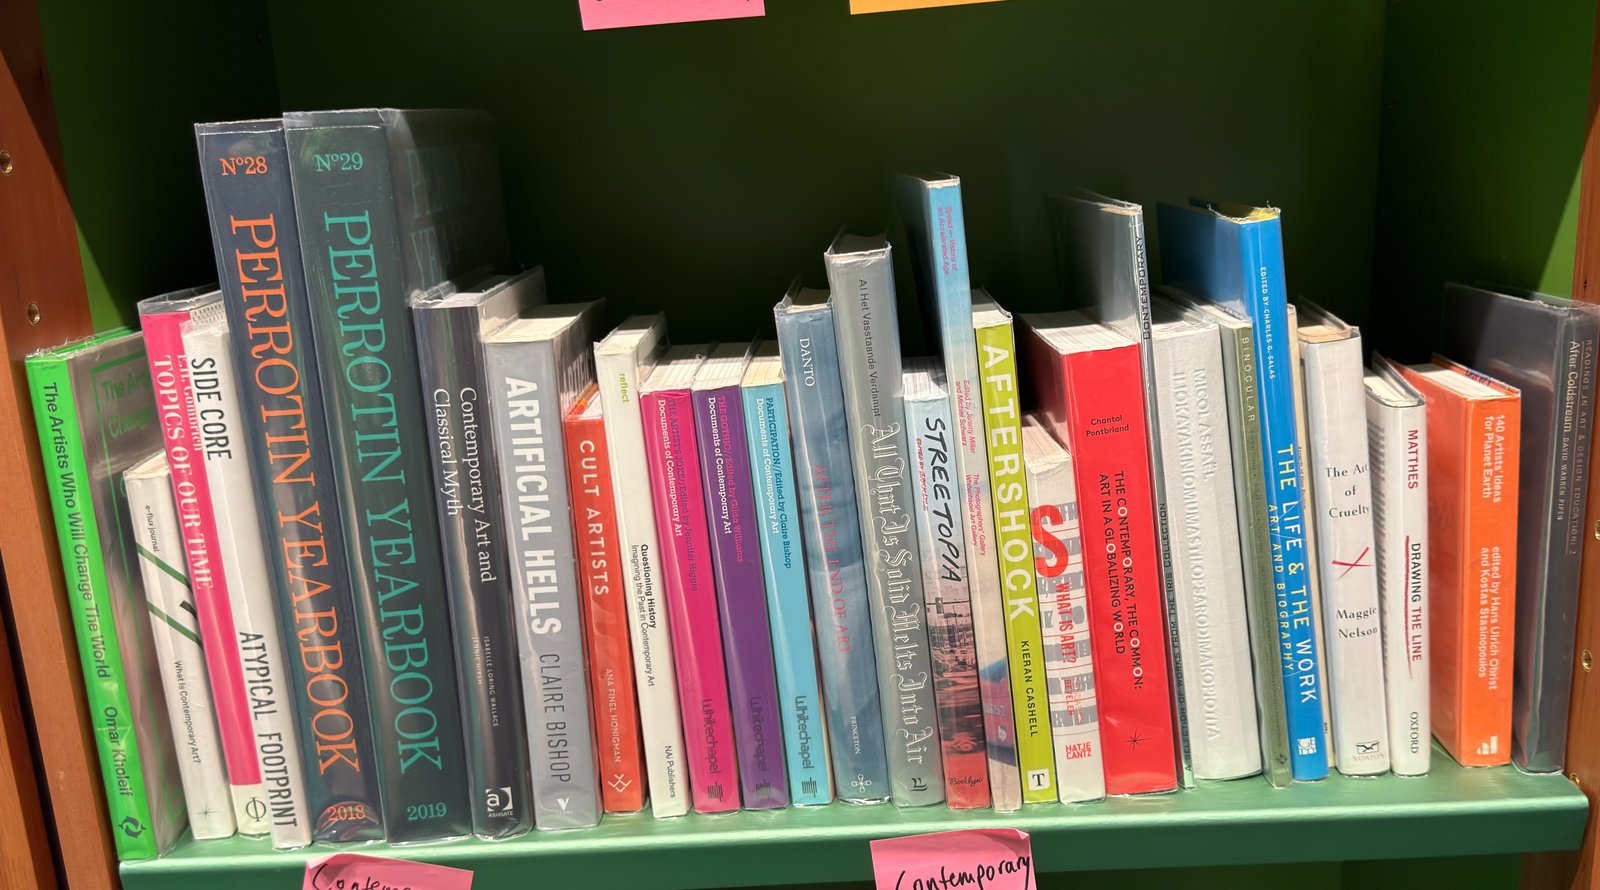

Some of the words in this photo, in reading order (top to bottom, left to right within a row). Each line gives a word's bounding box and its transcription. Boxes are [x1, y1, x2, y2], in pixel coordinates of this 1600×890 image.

[861, 293, 869, 310] Het
[1136, 236, 1150, 339] CONTEMPORARY
[863, 312, 876, 370] Vasstaande
[1569, 340, 1580, 368] After
[191, 357, 222, 402] SIDE
[800, 337, 816, 386] DANTO
[1242, 338, 1255, 422] BINOCULAR
[44, 382, 58, 412] The
[154, 355, 184, 440] TOPICS
[619, 373, 629, 403] reflect
[868, 371, 881, 417] Verdampt
[1564, 371, 1578, 433] Coldstream
[201, 409, 232, 460] CORE
[434, 388, 457, 467] Classical
[659, 399, 671, 449] Documents
[709, 397, 720, 447] Documents
[757, 398, 768, 447] Documents
[1086, 425, 1129, 437] Pontbriand
[1091, 415, 1122, 426] Chantal
[1485, 416, 1494, 430] for
[1496, 415, 1505, 432] 140
[50, 414, 68, 469] Artists
[460, 387, 485, 514] Contemporary
[505, 376, 553, 541] ARTIFICIAL
[665, 450, 672, 459] of
[715, 447, 722, 456] of
[763, 448, 769, 457] of
[861, 422, 901, 459] All
[1483, 433, 1493, 466] Planet
[172, 447, 192, 476] OF
[579, 440, 599, 496] CULT
[1277, 444, 1296, 490] THE
[1325, 467, 1348, 478] The
[1408, 430, 1418, 489] MATTHES
[60, 472, 76, 508] Who
[230, 213, 316, 486] PERROTIN
[278, 501, 360, 775] YEARBOOK
[323, 210, 405, 485] PERROTIN
[366, 498, 442, 774] YEARBOOK
[441, 470, 464, 516] Myth
[665, 460, 680, 522] Contemporary
[715, 458, 729, 520] Contemporary
[763, 458, 777, 520] Contemporary
[814, 463, 833, 514] AFTER
[868, 457, 906, 515] That
[925, 418, 962, 582] STREETOPIA
[983, 344, 1034, 621] AFTERSHOCK
[1099, 473, 1110, 497] ART
[1115, 471, 1125, 494] THE
[1345, 485, 1358, 497] of
[1483, 468, 1492, 498] Earth
[1493, 475, 1503, 503] Ideas
[178, 482, 201, 528] OUR
[1102, 500, 1111, 513] IN
[1103, 516, 1113, 525] A
[1269, 504, 1280, 533] ART
[1329, 505, 1370, 518] Cruelty
[67, 512, 85, 540] Will
[475, 519, 491, 547] Art
[724, 520, 732, 534] Art
[821, 522, 838, 550] THE
[872, 514, 910, 547] Is
[1159, 503, 1171, 567] COLLECTION
[1282, 501, 1302, 551] LIFE
[188, 533, 214, 590] TIME
[478, 550, 497, 583] and
[586, 508, 609, 595] ARTISTS
[630, 545, 642, 581] Imagining
[1104, 527, 1122, 608] GLOBALIZING
[1117, 497, 1135, 601] CONTEMPORARY,
[1273, 543, 1284, 572] AND
[1481, 547, 1489, 566] and
[1492, 546, 1500, 578] edited
[74, 544, 92, 602] Change
[641, 544, 653, 596] Questioning
[647, 598, 656, 628] History
[828, 559, 843, 594] END
[878, 549, 913, 604] Solid
[1288, 562, 1304, 575] &
[1411, 543, 1421, 602] DRAWING
[1480, 569, 1489, 605] Kostas
[1490, 581, 1500, 593] by
[524, 550, 562, 634] HELLS
[636, 582, 644, 594] the
[638, 596, 646, 612] Past
[1055, 582, 1071, 615] WHAT
[86, 604, 99, 632] The
[833, 597, 846, 619] OF
[1127, 603, 1137, 626] THE
[1290, 585, 1309, 629] THE
[1336, 607, 1377, 622] Maggie
[1412, 608, 1422, 630] THE
[1491, 597, 1499, 623] Hans
[836, 624, 852, 656] ART
[882, 602, 921, 671] Melts
[1059, 620, 1073, 632] IS
[1112, 612, 1126, 655] WORLD
[1277, 583, 1293, 671] BIOGRAPHY
[1338, 626, 1378, 639] Nelson
[1477, 607, 1488, 677] Stasinopoulos
[1490, 626, 1499, 655] Ulrich
[92, 634, 111, 678] World
[640, 622, 653, 674] Contemporary
[1021, 640, 1032, 683] KIERAN
[1060, 635, 1076, 664] ART?
[1129, 630, 1143, 689] COMMON:
[1412, 636, 1422, 661] LINE
[175, 660, 184, 682] What
[539, 654, 564, 713] CLAIRE
[1295, 639, 1316, 703] WORK
[1489, 658, 1498, 689] Obrist
[890, 672, 927, 725] Into
[1026, 688, 1038, 737] CASHELL
[179, 690, 196, 746] Contemporary
[239, 632, 277, 720] ATYPICAL
[258, 732, 298, 827] FOOTPRINT
[702, 698, 722, 774] Whitechapel
[751, 696, 769, 772] Whitechapel
[795, 696, 814, 769] Whitechapel
[1179, 707, 1190, 760] SELECTION
[1410, 712, 1419, 753] OXFORD
[104, 707, 120, 746] Omar
[112, 749, 132, 797] Kholeif
[191, 747, 200, 764] Art?
[546, 721, 570, 782] BISHOP
[896, 726, 934, 764] Air
[1065, 742, 1091, 751] HATJE
[1066, 750, 1092, 760] CANTZ
[667, 761, 675, 798] Publishers
[327, 804, 366, 821] 2018
[407, 802, 446, 820] 2019
[488, 810, 513, 818] ASHGATE
[896, 856, 1030, 890] Contemporary
